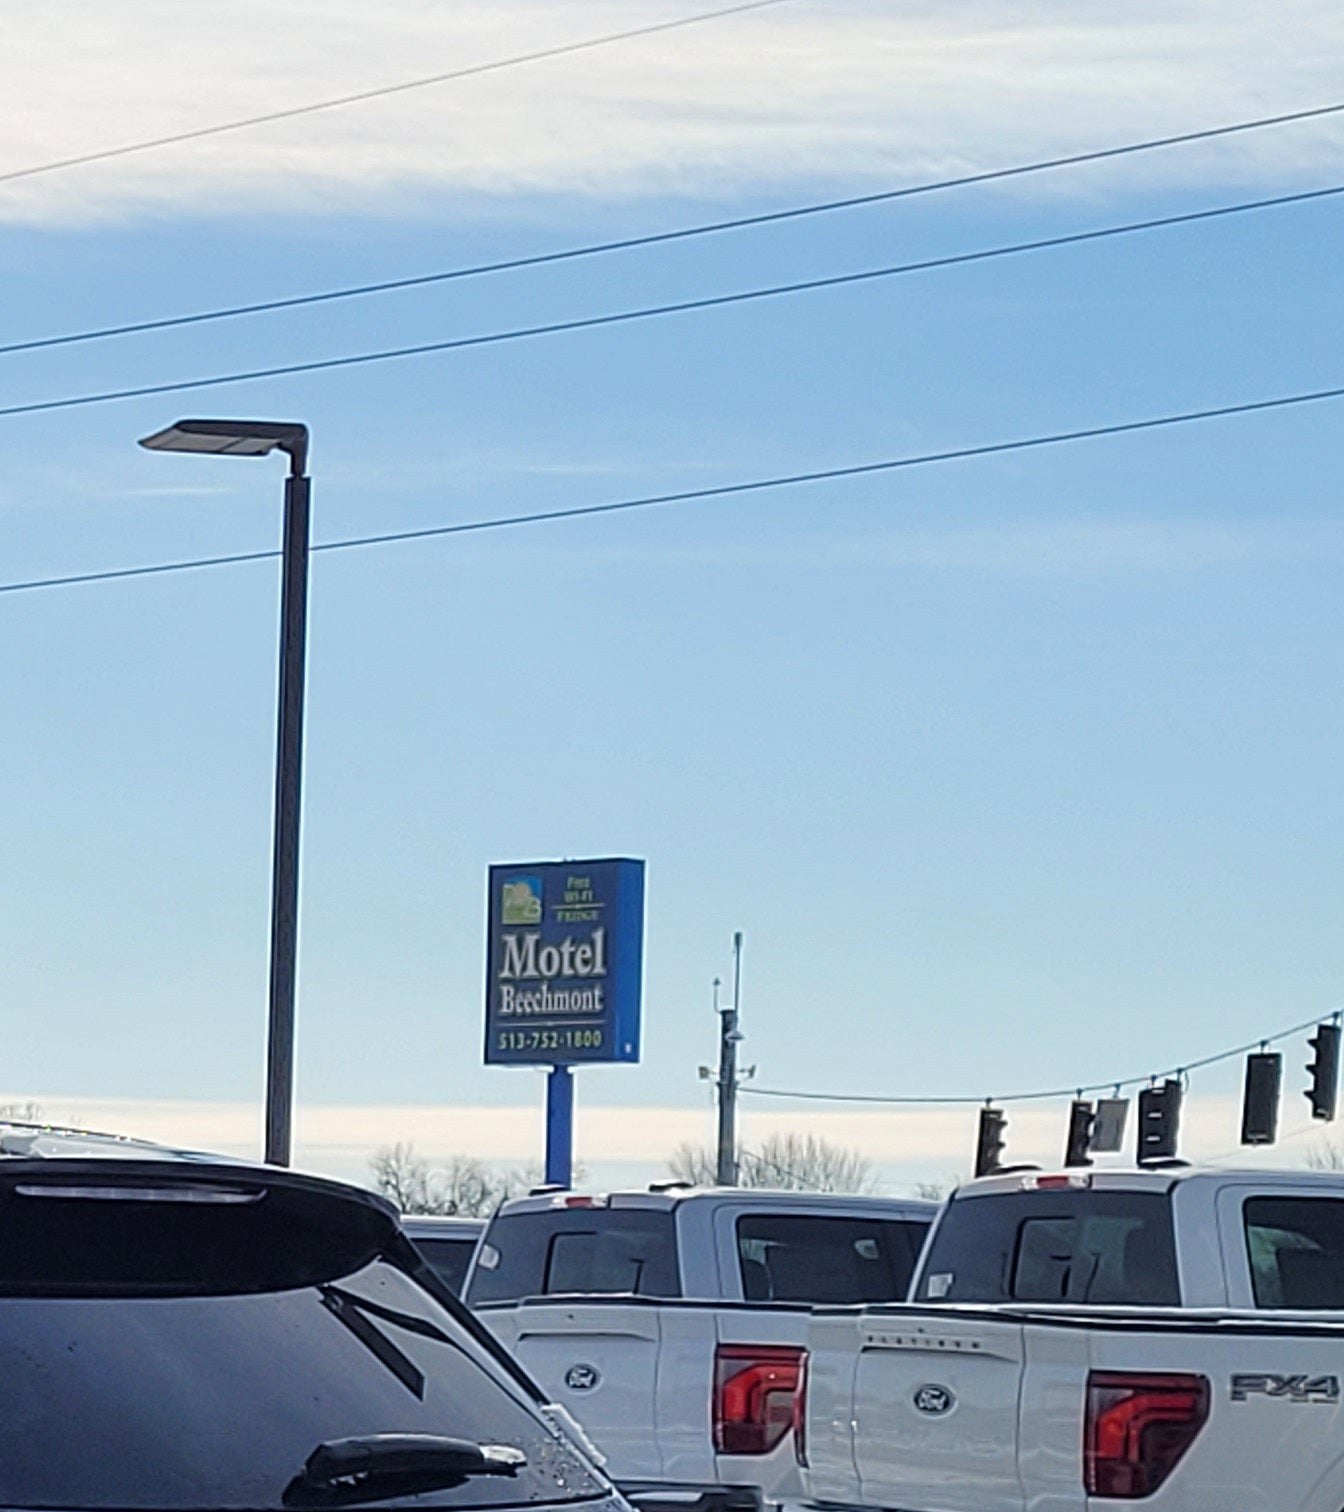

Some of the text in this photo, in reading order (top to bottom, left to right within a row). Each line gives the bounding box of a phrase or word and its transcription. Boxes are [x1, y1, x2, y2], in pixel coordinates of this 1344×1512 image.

[498, 926, 607, 979] Motel
[499, 981, 604, 1014] Beechmont
[497, 1029, 602, 1050] 513-752-1800
[1230, 1374, 1339, 1402] FX4
